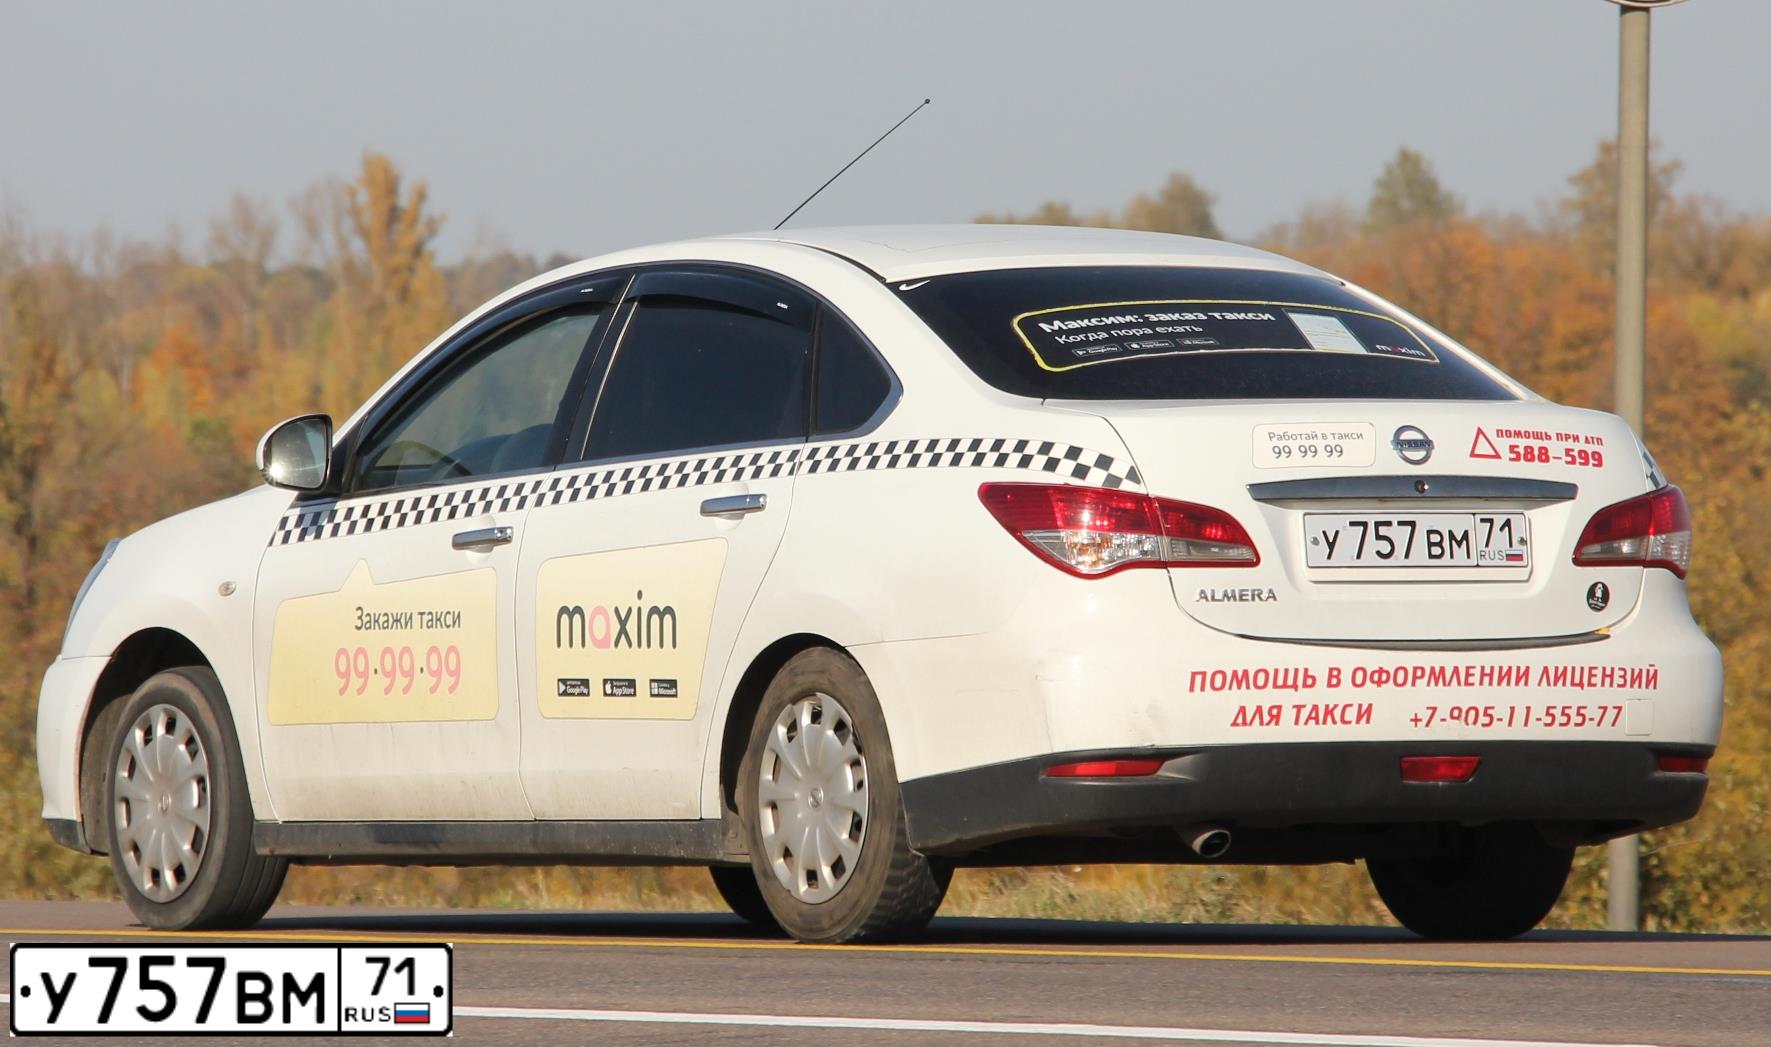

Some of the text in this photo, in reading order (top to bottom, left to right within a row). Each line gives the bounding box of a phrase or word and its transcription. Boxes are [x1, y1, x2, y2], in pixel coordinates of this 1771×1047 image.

[1038, 312, 1277, 333] Максим: заказ такси
[1055, 324, 1203, 344] Когда пора ехать
[1268, 430, 1364, 441] Работай в такси
[1396, 439, 1432, 448] NISSAN
[1496, 429, 1552, 441] ПОМОЩЬ
[1556, 432, 1580, 444] ПРИ
[1272, 444, 1344, 459] 99 99 99
[1508, 444, 1603, 468] 588-599
[1479, 518, 1513, 548] 71
[1479, 550, 1505, 561] RUS
[1196, 588, 1278, 602] ALMERA
[354, 606, 461, 631] Закажи такси
[556, 589, 677, 649] maxim
[1189, 664, 1658, 692] ПОМОЩЬ В ОФОРМЛЕНИИ ЛИЦЕНЗИЙ
[1230, 703, 1623, 728] ДЛЯ ТАКСИ +7-905-11-555-77
